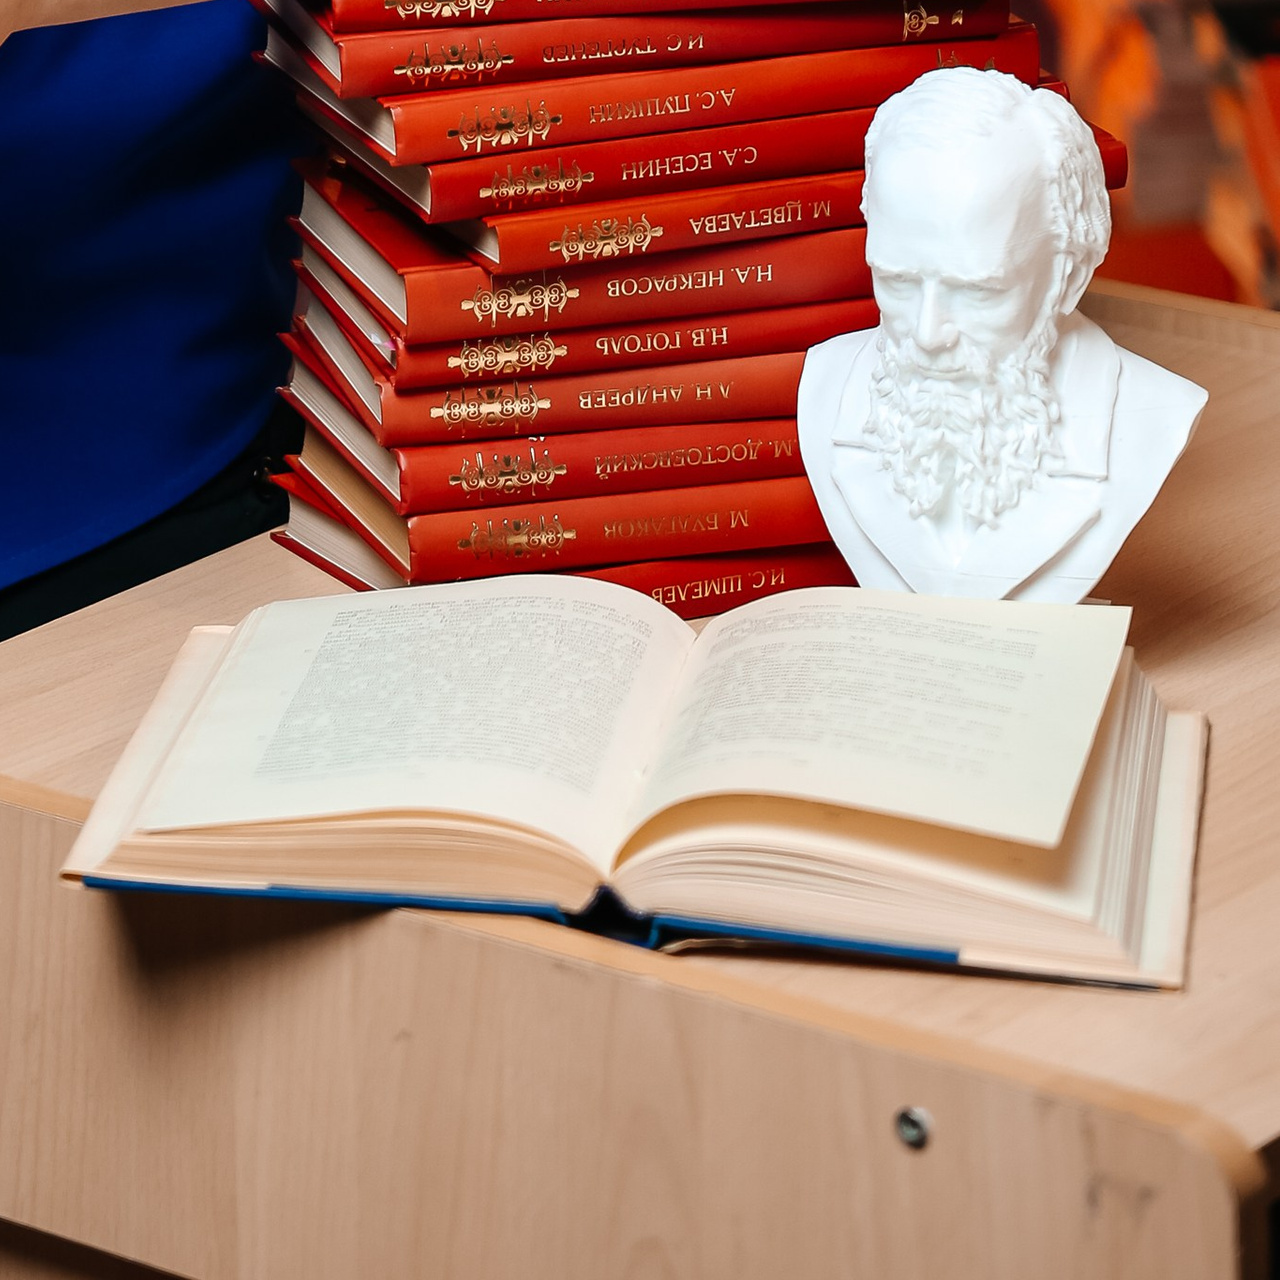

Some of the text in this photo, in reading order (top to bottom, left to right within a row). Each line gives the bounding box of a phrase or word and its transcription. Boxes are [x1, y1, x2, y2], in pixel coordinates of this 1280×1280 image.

[542, 36, 657, 63] ТУРГЕНЕВ
[588, 88, 736, 124] А.С. ПУШКИН
[621, 146, 758, 181] С.А. ЕСЕНИН
[689, 200, 831, 235] М. ЦВЕТАЕВА
[606, 264, 773, 297] Н.А. НЕКРАСОВ
[595, 327, 728, 355] Н.В. ГОГОЛЬ
[578, 384, 685, 409] АНДРЕЕВ
[594, 439, 763, 480] ДОСТОЕВСКИЙ
[603, 511, 718, 539] БУЛГАКОВ
[651, 568, 785, 605] И.С. ШМЕЛЕВ
